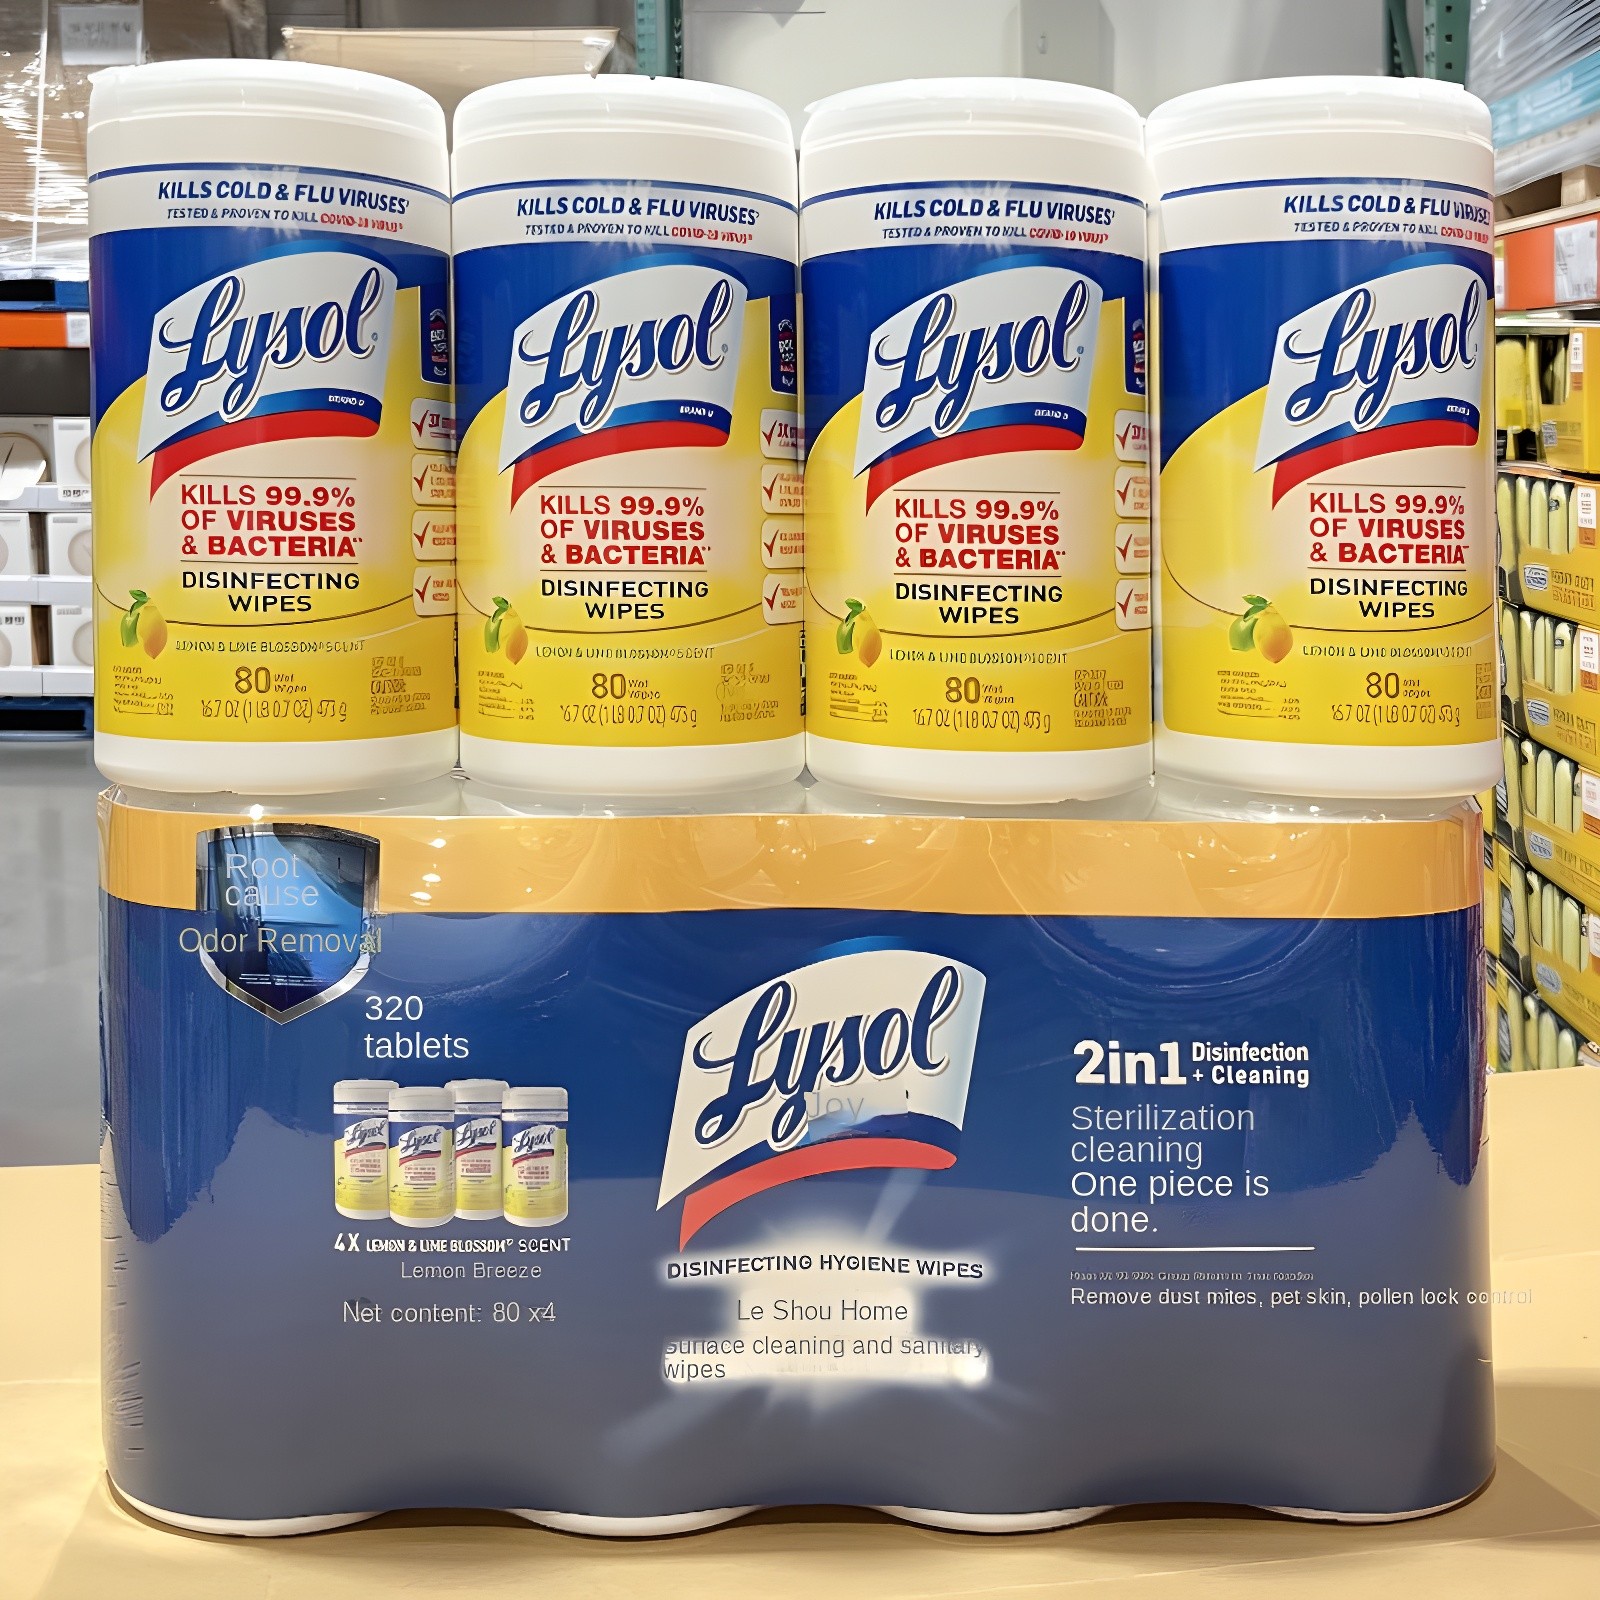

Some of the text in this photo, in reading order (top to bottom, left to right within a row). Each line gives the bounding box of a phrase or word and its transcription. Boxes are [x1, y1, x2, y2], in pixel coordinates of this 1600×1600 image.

[158, 181, 212, 200] KILLS
[216, 181, 272, 199] COLD
[275, 183, 289, 200] &
[294, 184, 334, 204] FLU
[167, 208, 208, 219] TESTED
[274, 209, 288, 220] TO
[517, 197, 569, 216] KILLS
[572, 197, 624, 215] COLD
[628, 198, 642, 215] &
[647, 199, 685, 217] FLU
[874, 199, 926, 220] KILLS
[930, 199, 984, 217] COLD
[987, 199, 1000, 217] &
[1005, 200, 1043, 218] FLU
[1284, 194, 1344, 213] KILLS
[1348, 195, 1401, 212] COLD
[1403, 197, 1416, 214] &
[1419, 198, 1451, 217] FLU
[628, 224, 642, 235] TO
[934, 225, 982, 237] PROVEN
[985, 226, 1000, 237] TO
[1403, 223, 1416, 233] TO
[158, 267, 383, 423] Lysol
[519, 278, 734, 434] Lysol
[874, 280, 1089, 438] Lysol
[1283, 279, 1480, 433] Lysol
[181, 484, 355, 508] KILLS 99.9%
[540, 495, 704, 517] KILLS 99.9%
[1310, 493, 1465, 515] KILLS 99.9%
[895, 498, 1059, 521] KILLS 99.9%
[181, 509, 356, 532] OF VIRUSES
[540, 520, 705, 541] OF VIRUSES
[1309, 517, 1465, 540] OF VIRUSES
[181, 535, 198, 555] &
[895, 523, 1059, 546] OF VIRUSES
[540, 545, 555, 564] &
[895, 547, 911, 568] &
[1310, 543, 1328, 562] &
[182, 571, 360, 590] DISINFECTING
[541, 579, 709, 598] DISINFECTING
[1310, 578, 1468, 596] DISINFECTING
[895, 583, 1063, 602] DISINFECTING
[228, 594, 312, 613] WIPES
[585, 602, 665, 620] WIPES
[1359, 600, 1435, 618] WIPES
[939, 607, 1019, 624] WIPES
[234, 665, 271, 694] 80
[591, 672, 627, 700] 80
[945, 676, 980, 704] 80
[1366, 671, 1400, 698] 80
[692, 965, 964, 1151] Lysol
[1073, 1039, 1187, 1085] 2in1
[1192, 1041, 1310, 1062] Disinfection
[1211, 1065, 1310, 1088] Cleaning
[334, 1233, 360, 1251] 4X
[420, 1239, 448, 1253] LIME
[518, 1237, 571, 1252] SCENT
[917, 1259, 984, 1279] WIPES
